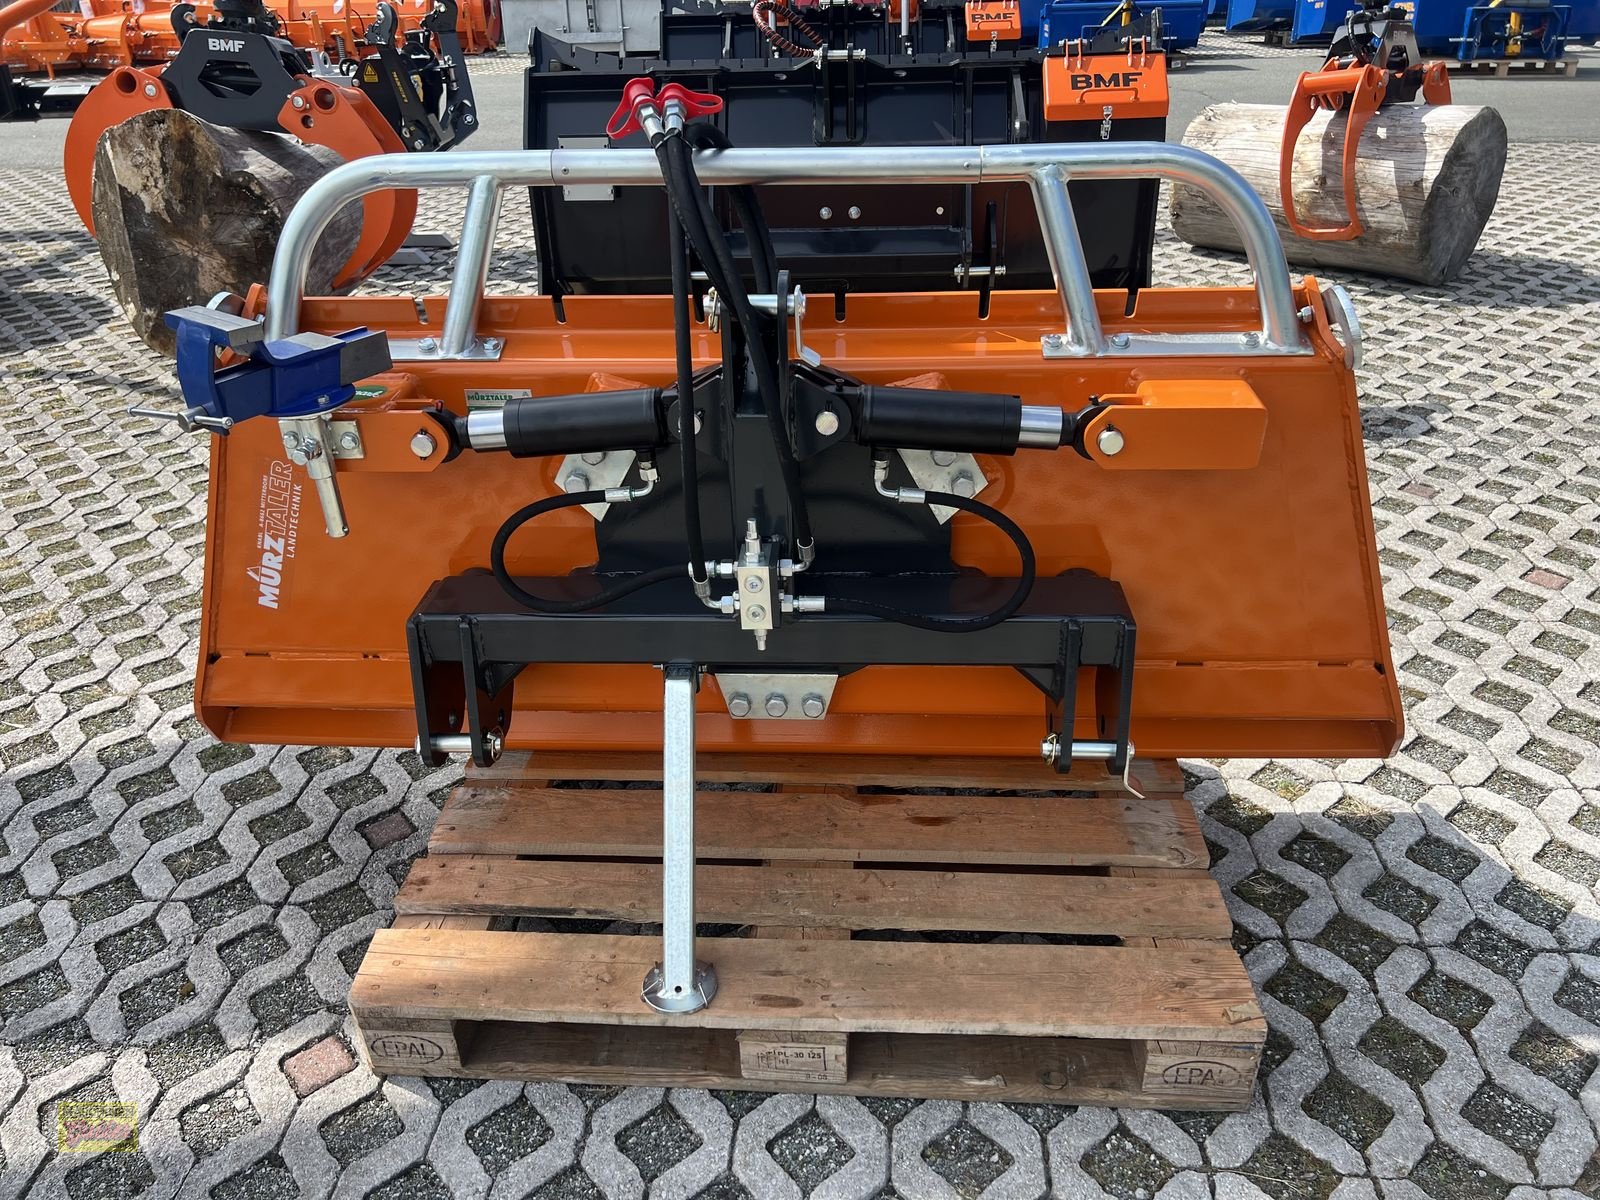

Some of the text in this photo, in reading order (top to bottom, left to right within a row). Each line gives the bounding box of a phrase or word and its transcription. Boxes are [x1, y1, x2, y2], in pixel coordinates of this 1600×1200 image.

[971, 12, 1015, 23] BMF
[208, 38, 245, 52] BMF
[1070, 72, 1142, 90] BMF
[287, 484, 302, 558] LANDTECHNIK
[382, 1041, 434, 1059] EPAL
